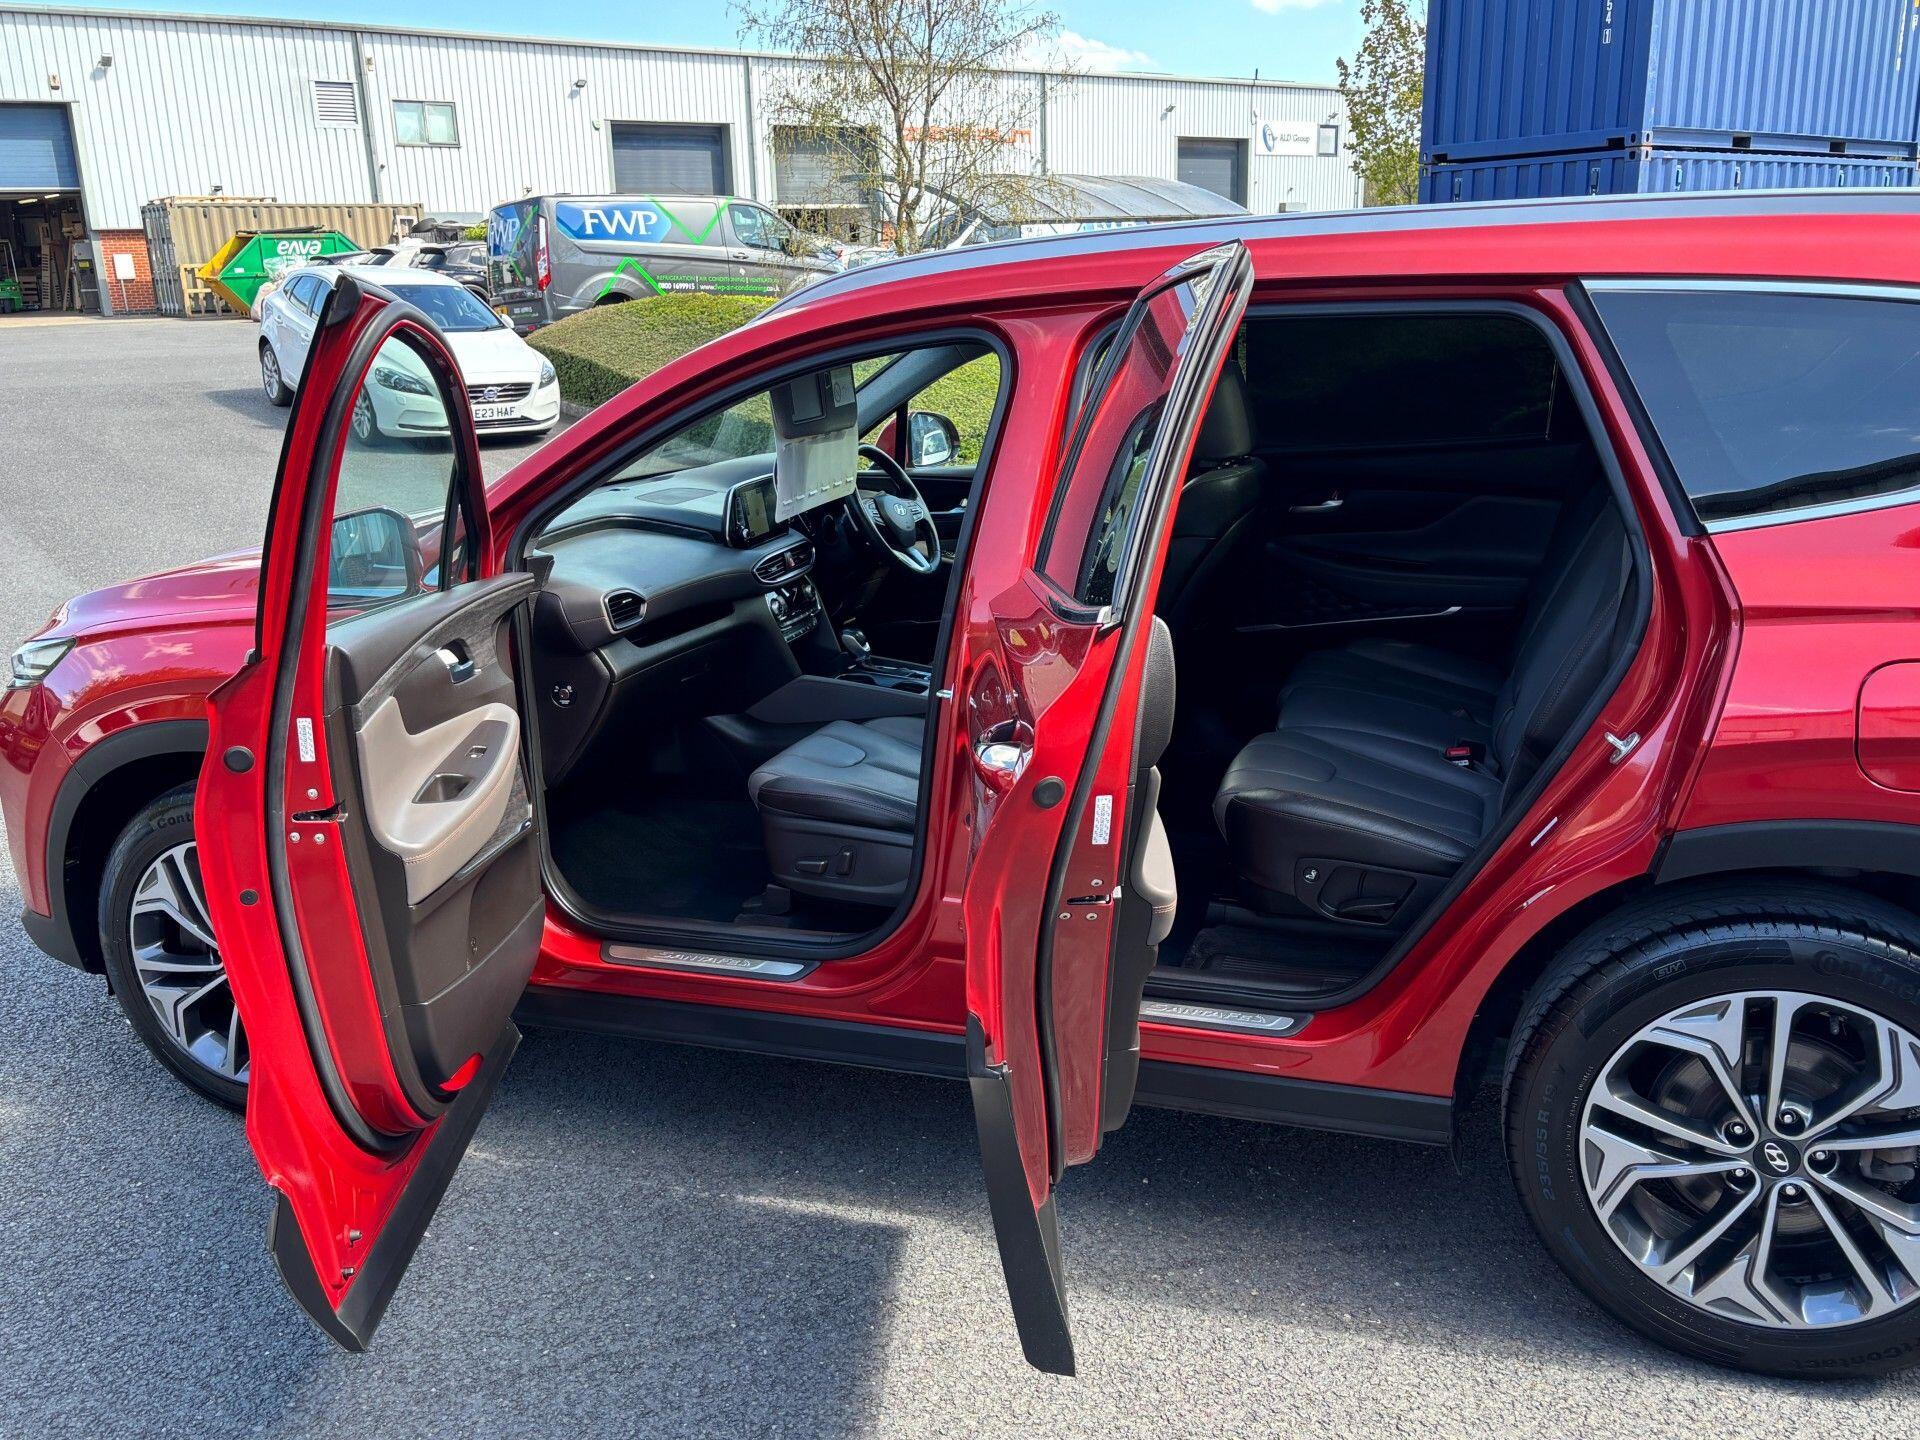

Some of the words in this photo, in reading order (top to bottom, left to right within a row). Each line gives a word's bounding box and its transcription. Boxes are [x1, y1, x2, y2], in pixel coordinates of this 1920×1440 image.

[1293, 133, 1311, 144] Group
[582, 209, 658, 236] FWP
[496, 406, 515, 417] HAF
[1658, 960, 1683, 978] SUV
